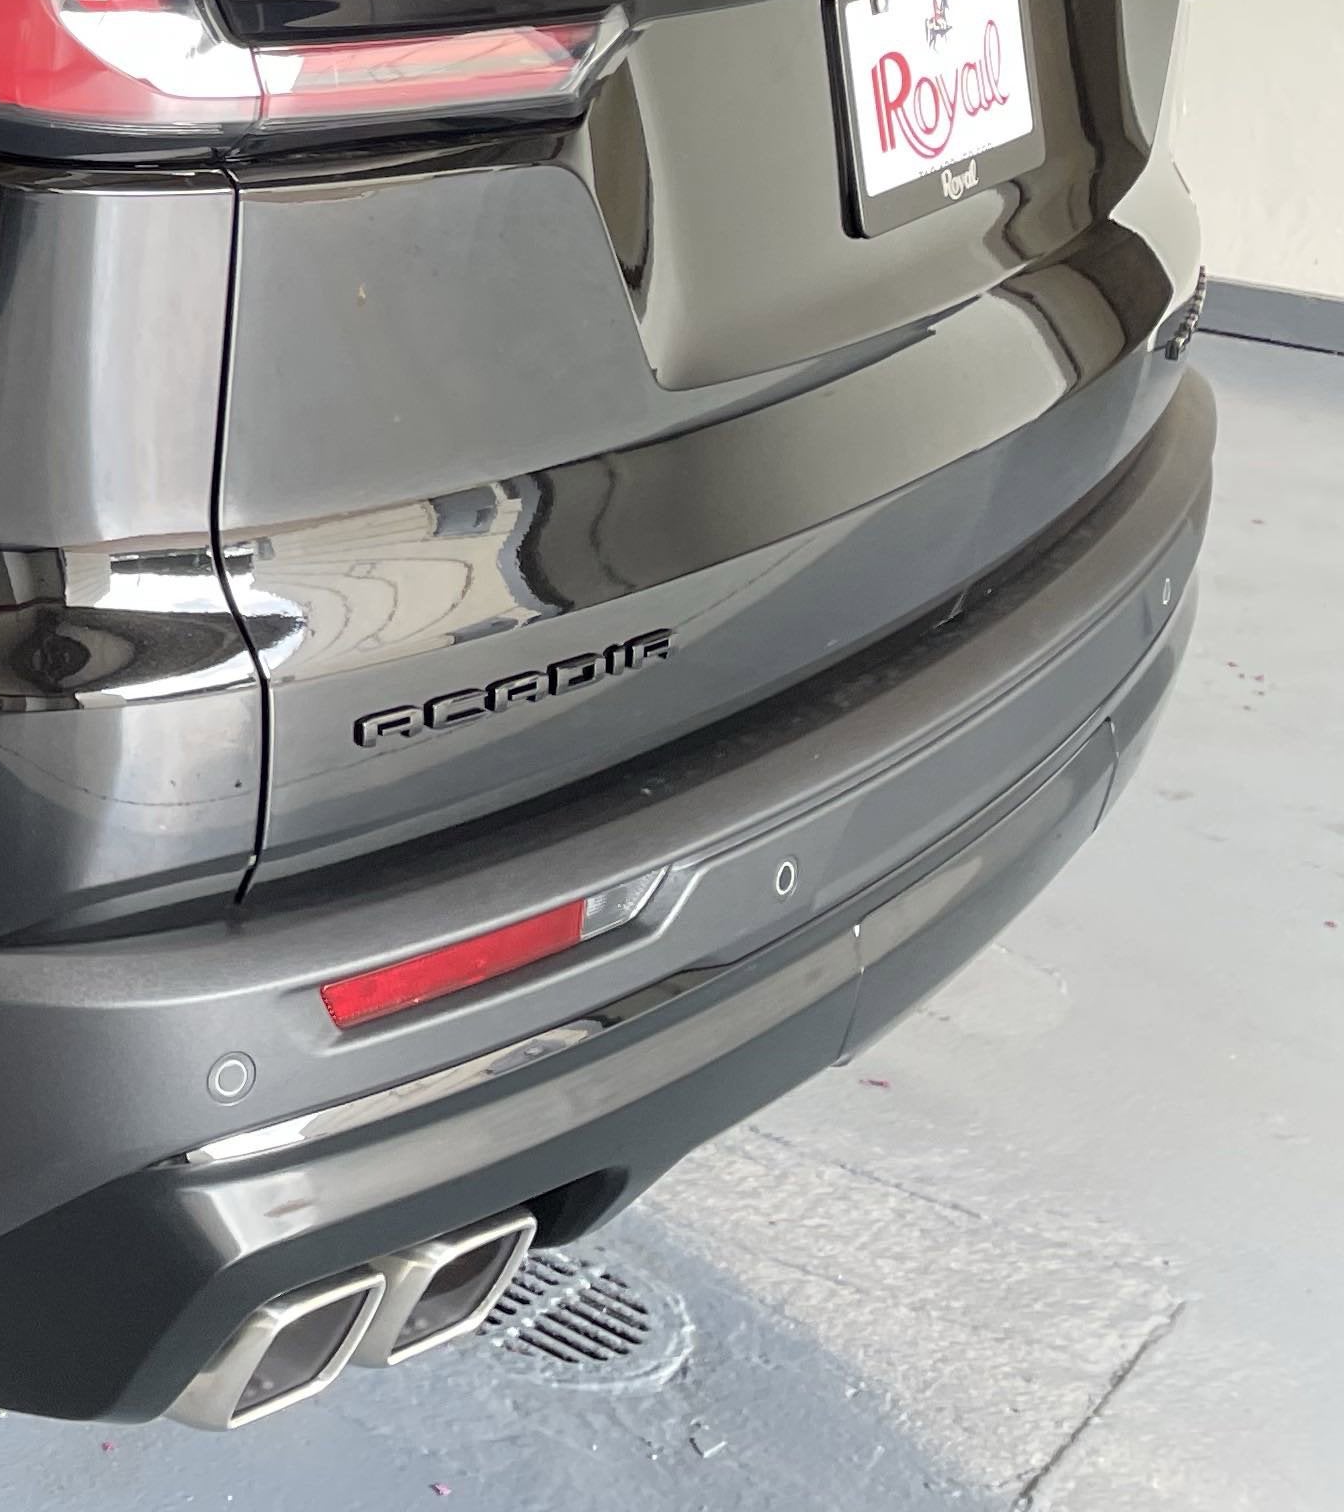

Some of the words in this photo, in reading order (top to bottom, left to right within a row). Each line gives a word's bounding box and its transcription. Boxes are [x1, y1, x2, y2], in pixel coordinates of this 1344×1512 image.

[871, 19, 1010, 159] Royal
[941, 158, 979, 200] Royal
[353, 627, 679, 749] ACADIA
